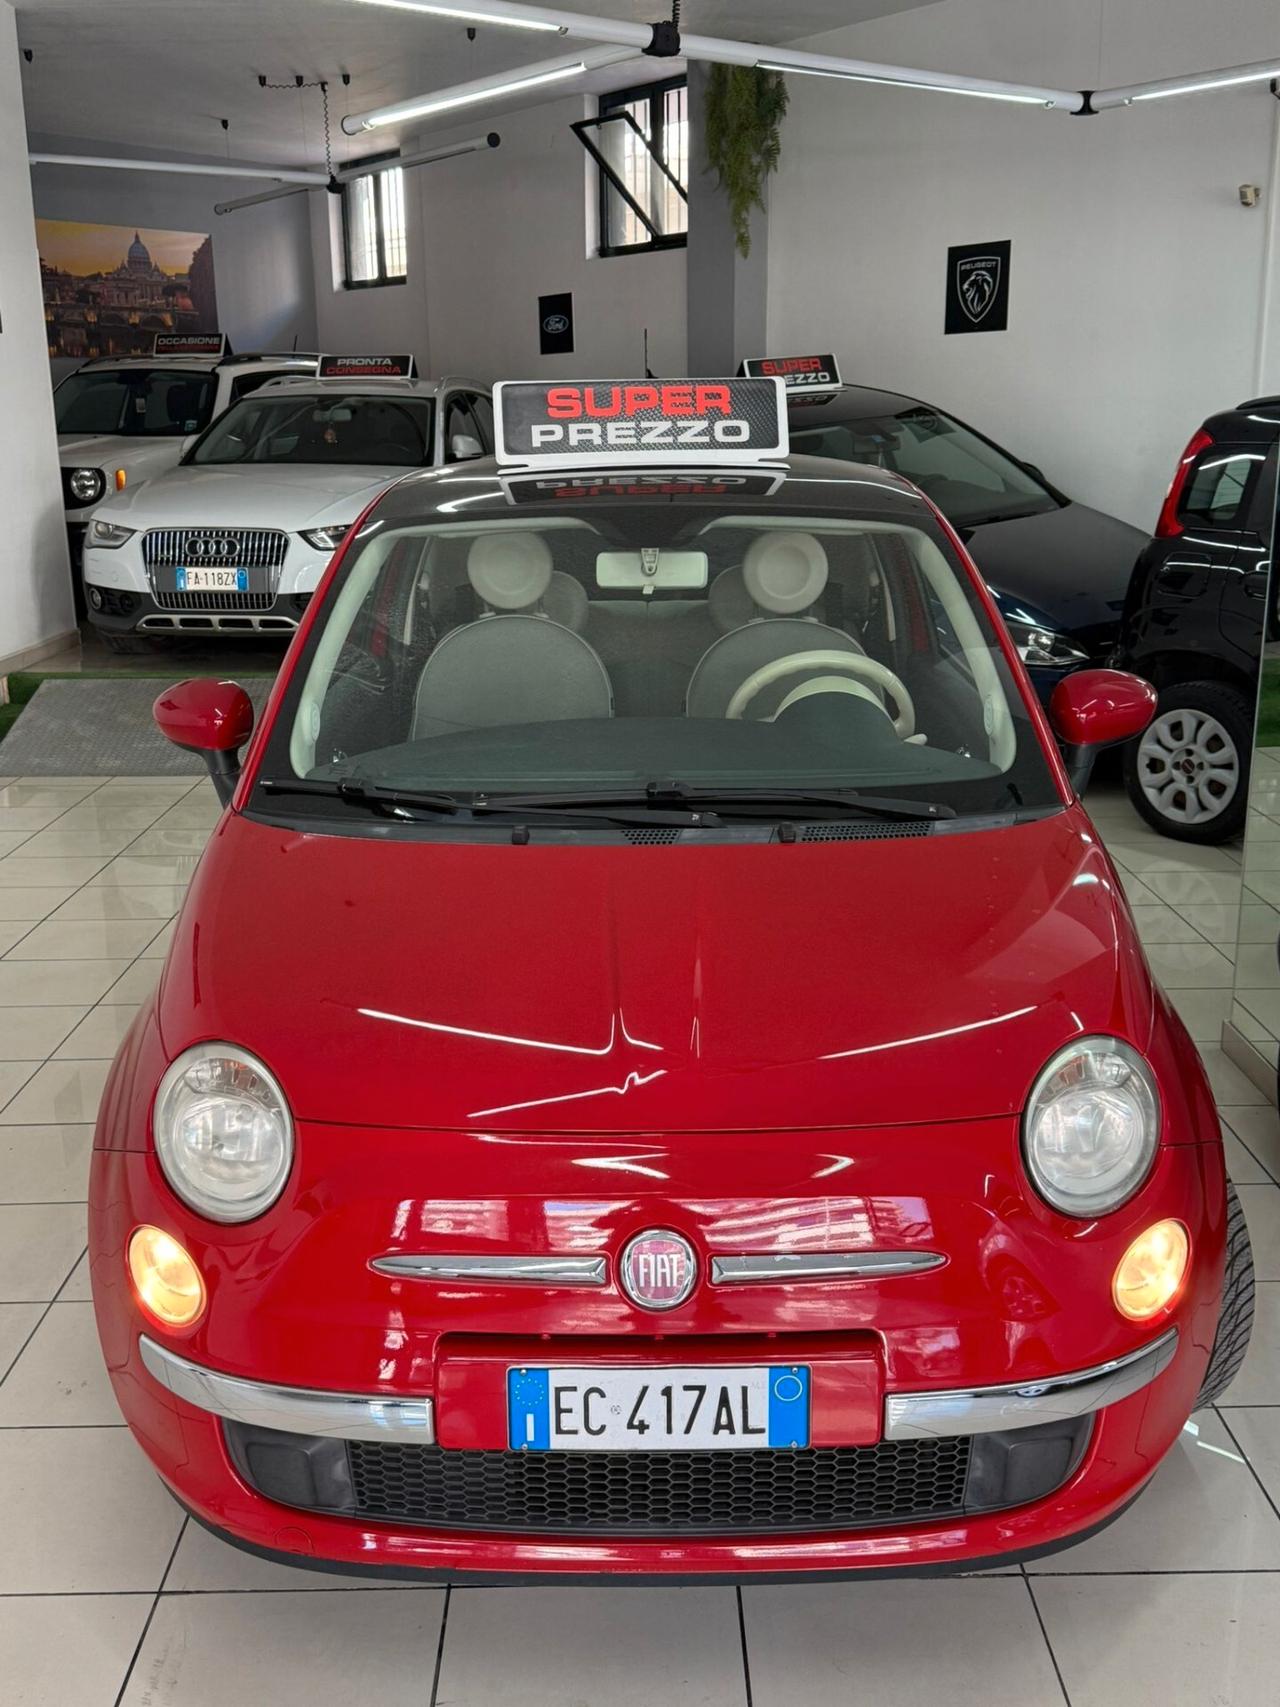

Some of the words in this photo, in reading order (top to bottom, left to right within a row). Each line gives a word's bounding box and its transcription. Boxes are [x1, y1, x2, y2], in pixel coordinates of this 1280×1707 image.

[961, 261, 997, 270] PEUGEOT
[158, 337, 221, 345] OCCASIONE
[337, 358, 392, 366] PRONTA
[761, 358, 822, 375] SUPER
[784, 372, 830, 385] EZZO
[547, 385, 731, 418] SUPER
[531, 420, 750, 447] PREZZO
[639, 1253, 681, 1288] FIAT
